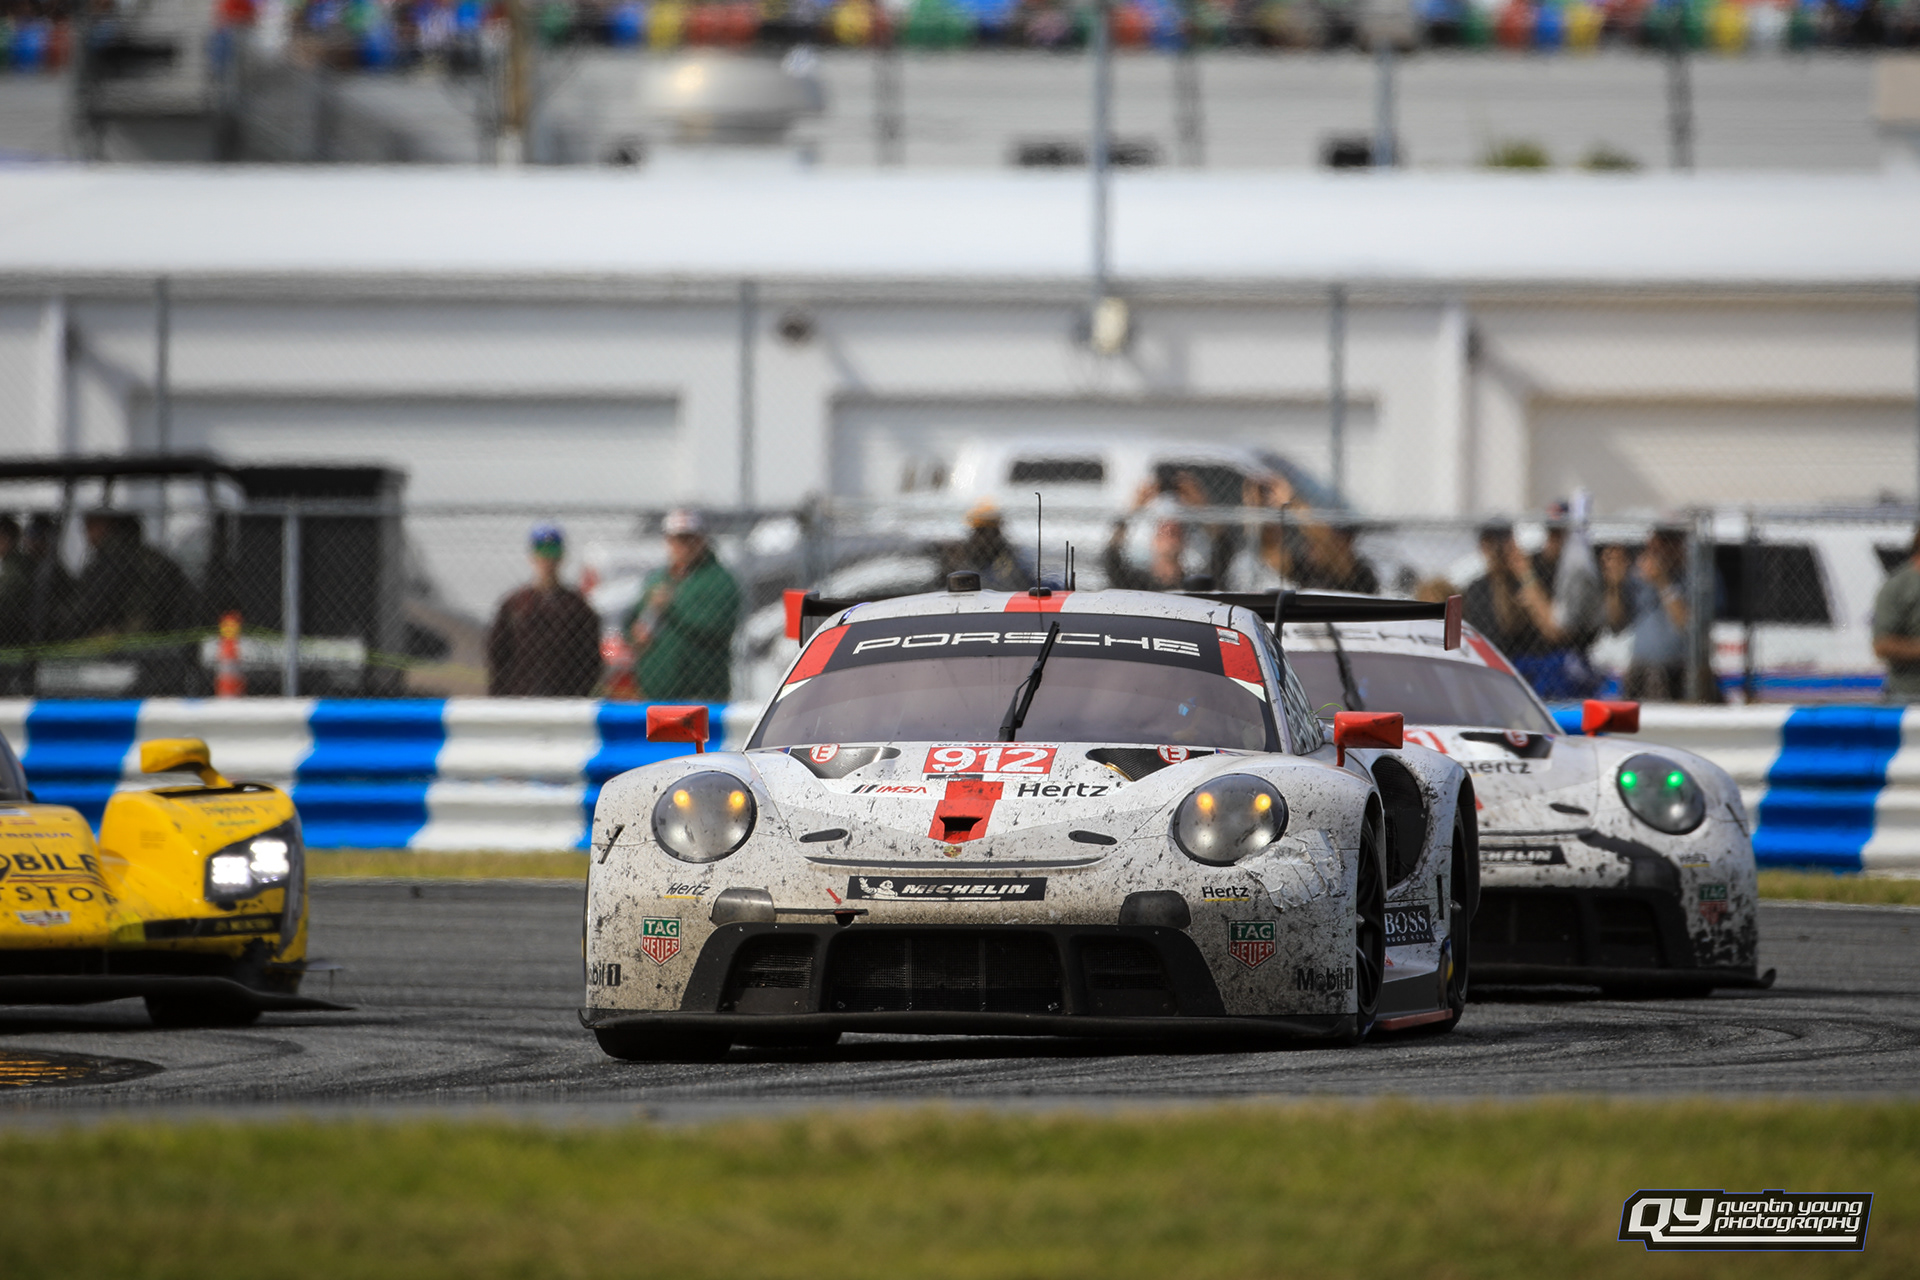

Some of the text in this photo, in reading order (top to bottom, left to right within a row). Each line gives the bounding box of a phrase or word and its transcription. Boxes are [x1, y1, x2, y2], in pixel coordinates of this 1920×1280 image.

[852, 631, 1201, 658] PORSCHE
[815, 745, 831, 760] E
[931, 747, 1049, 773] 912
[1166, 747, 1182, 761] E
[875, 785, 928, 794] IMSA
[1017, 782, 1111, 798] Hertz
[665, 882, 711, 896] Hertz
[901, 884, 1031, 895] MICHELIN
[1202, 885, 1250, 898] Hertz
[645, 921, 678, 936] TAG
[1384, 911, 1428, 935] BOSS
[1236, 924, 1272, 939] TAG
[643, 938, 679, 963] HEUER
[1231, 943, 1273, 965] HEUER
